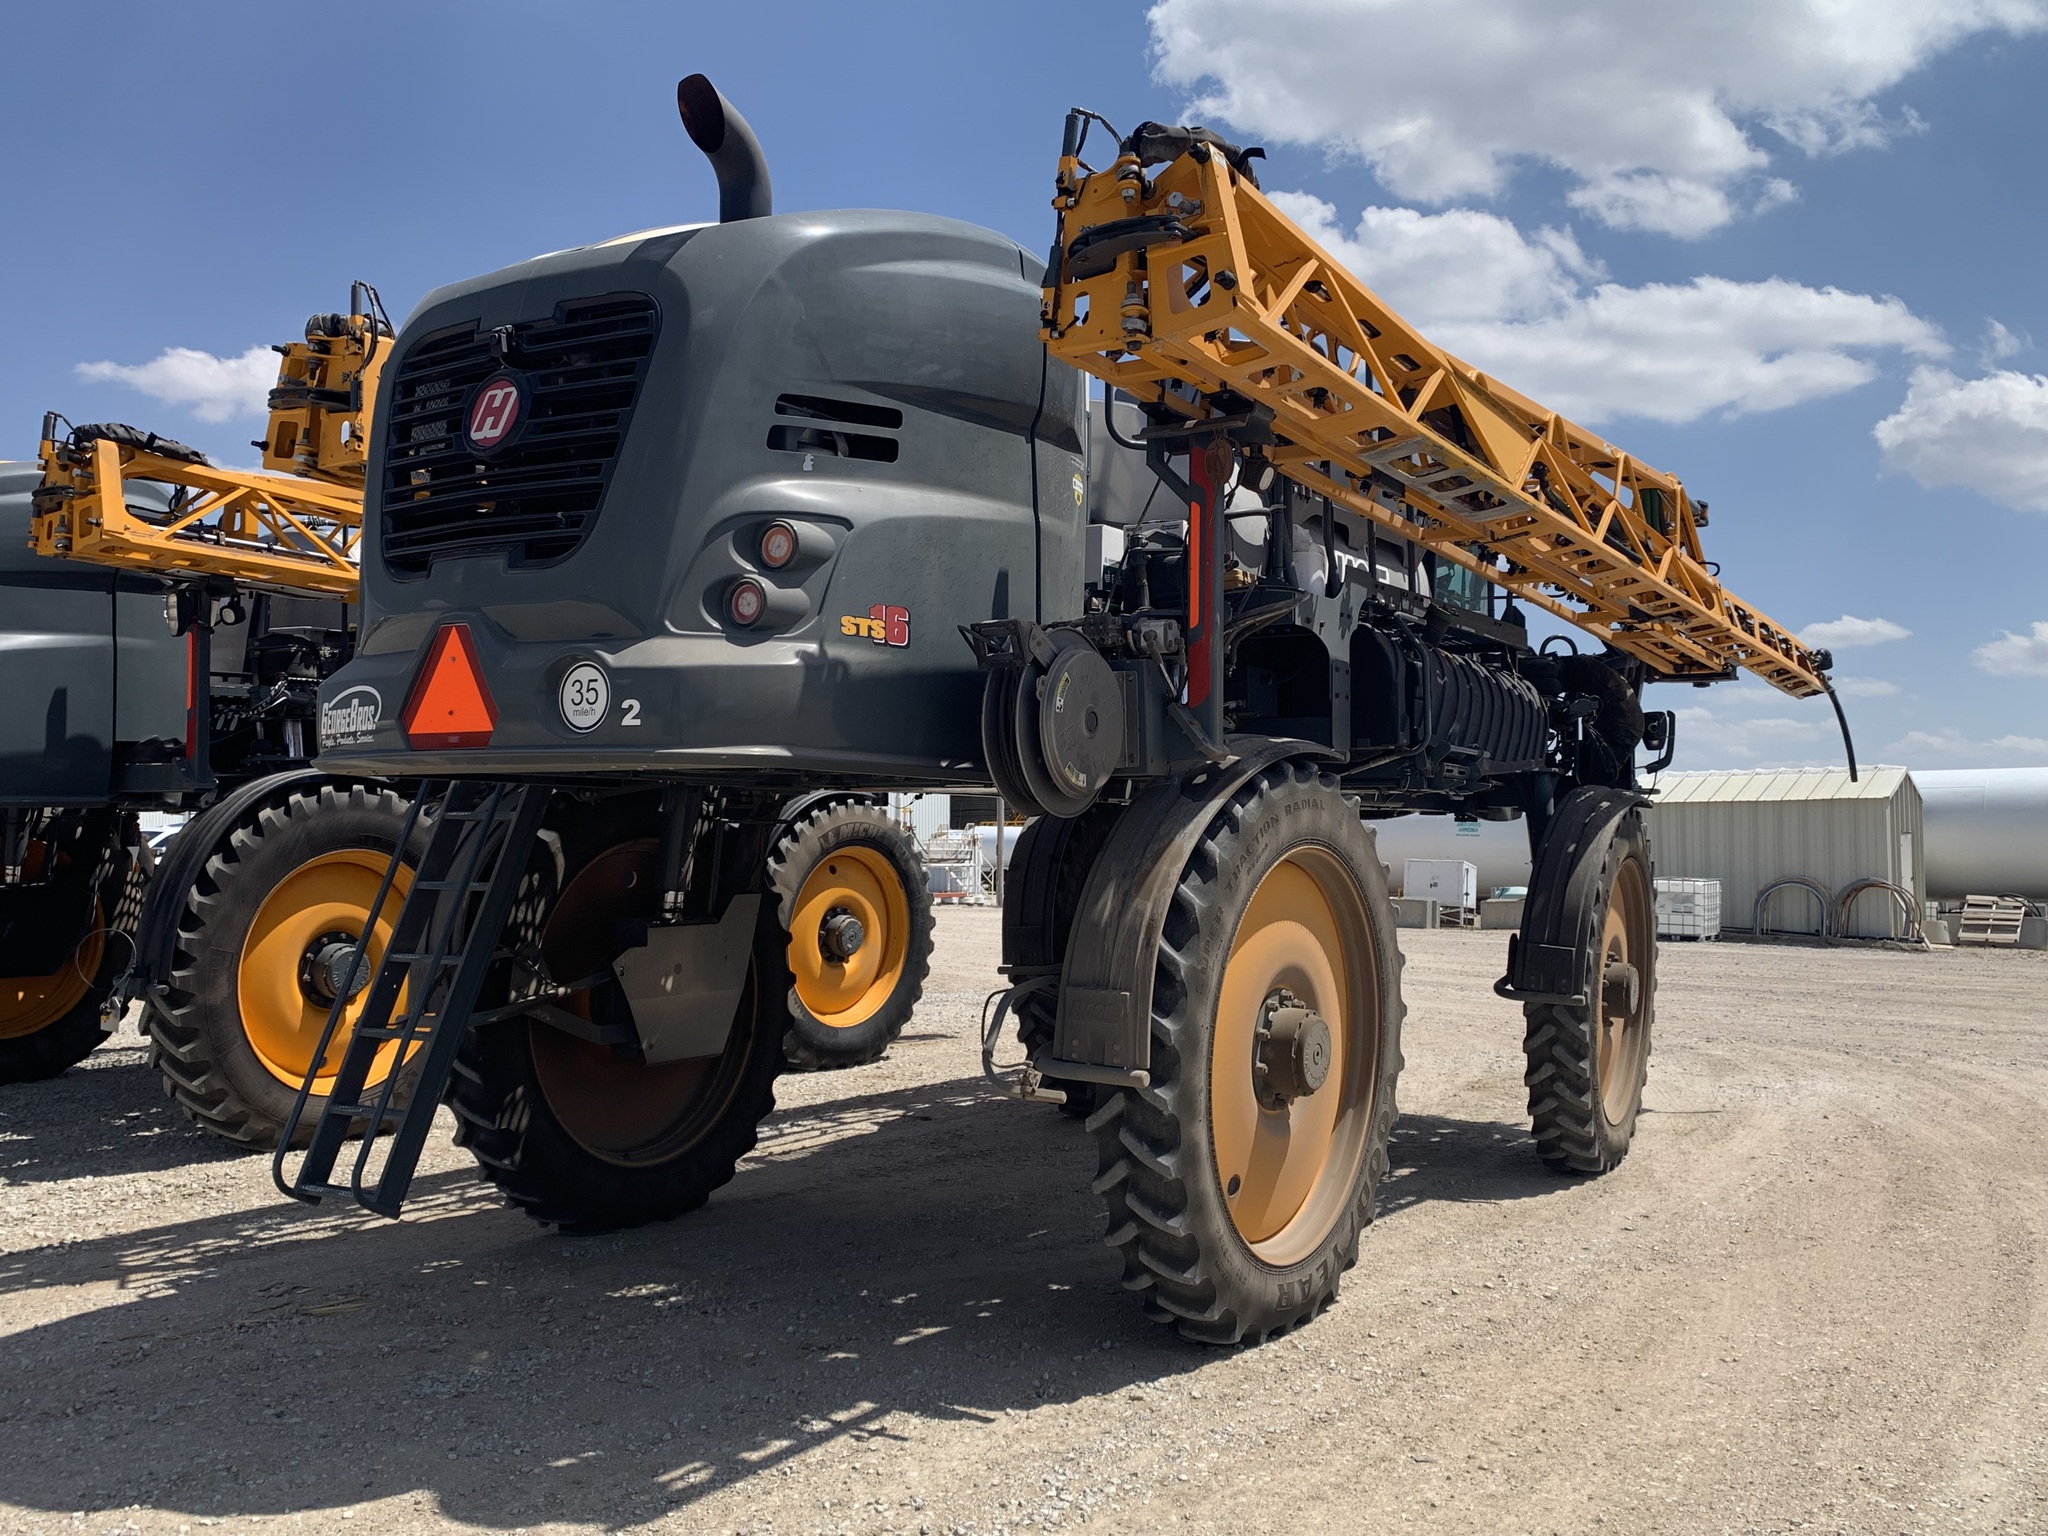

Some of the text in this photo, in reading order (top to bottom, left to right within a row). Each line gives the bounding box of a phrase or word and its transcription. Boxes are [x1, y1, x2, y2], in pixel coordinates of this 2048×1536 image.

[571, 678, 599, 706] 35
[573, 707, 596, 717] mile/h
[620, 698, 642, 727] 2
[1225, 813, 1280, 893] TRACTION
[1284, 797, 1326, 818] RADIAL
